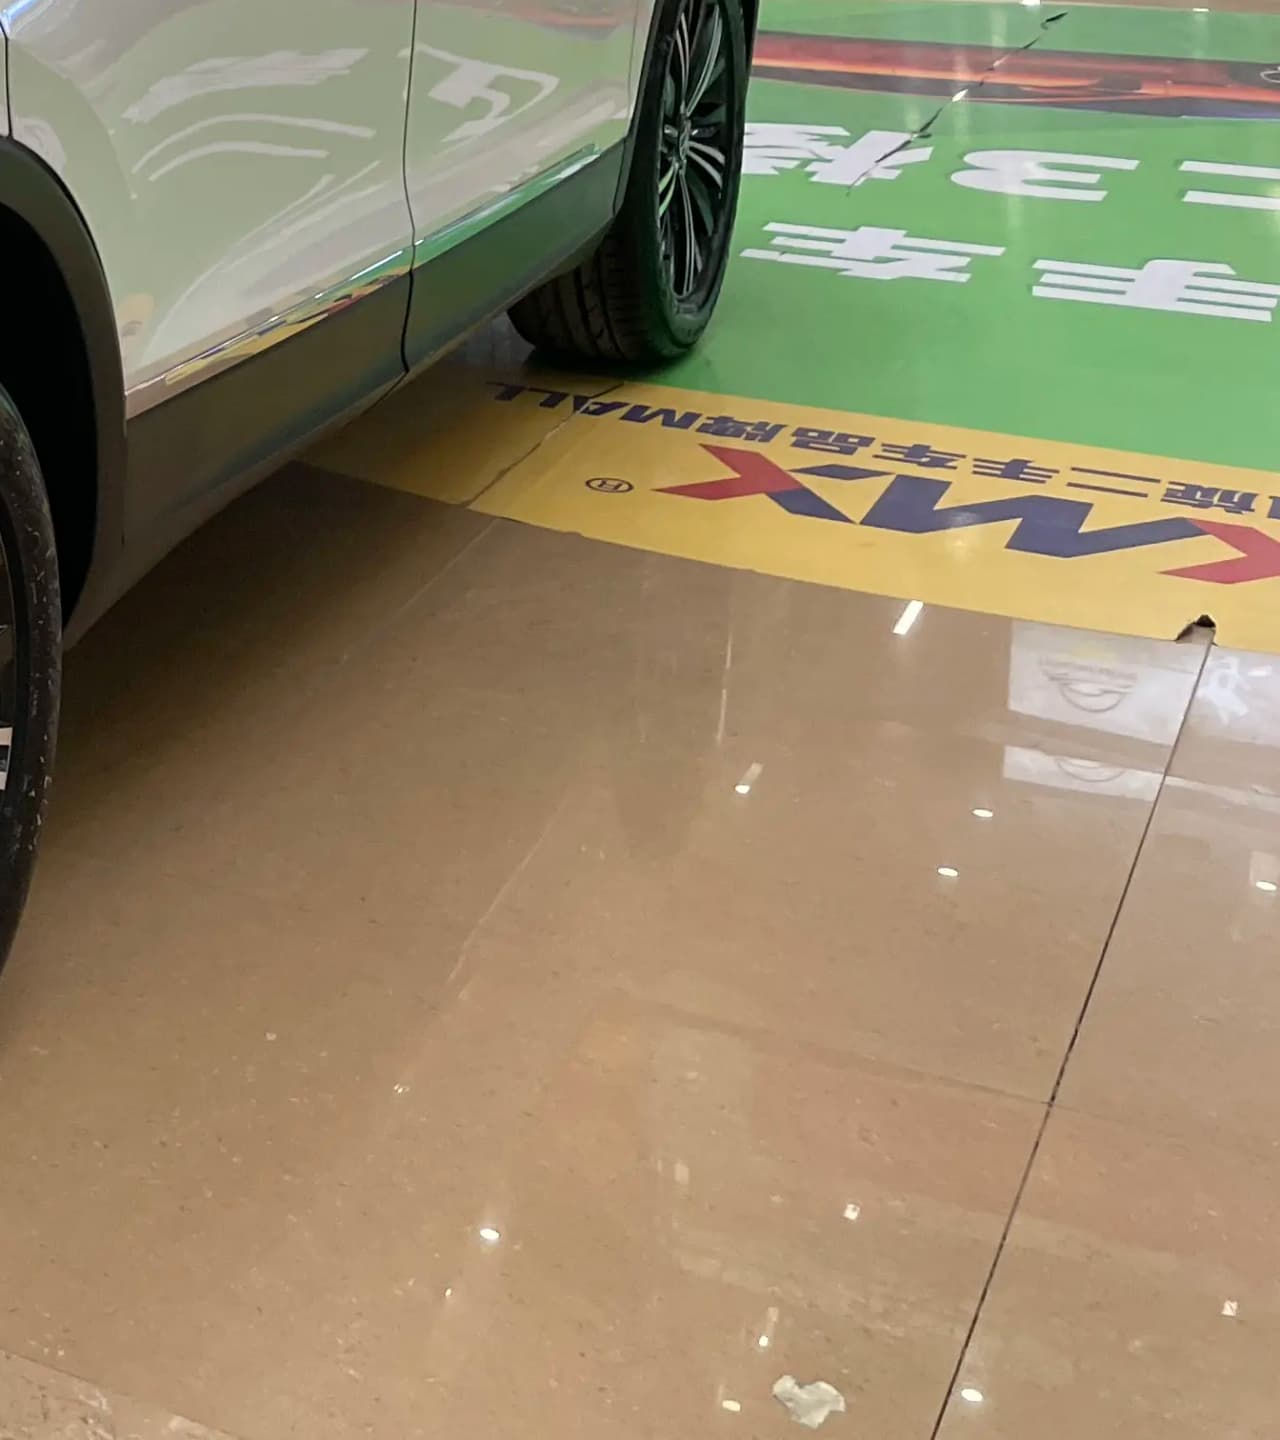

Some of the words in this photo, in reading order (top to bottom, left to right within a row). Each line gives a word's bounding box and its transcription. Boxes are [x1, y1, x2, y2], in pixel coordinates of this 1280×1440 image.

[488, 381, 1280, 517] 旋二手车品牌MALL
